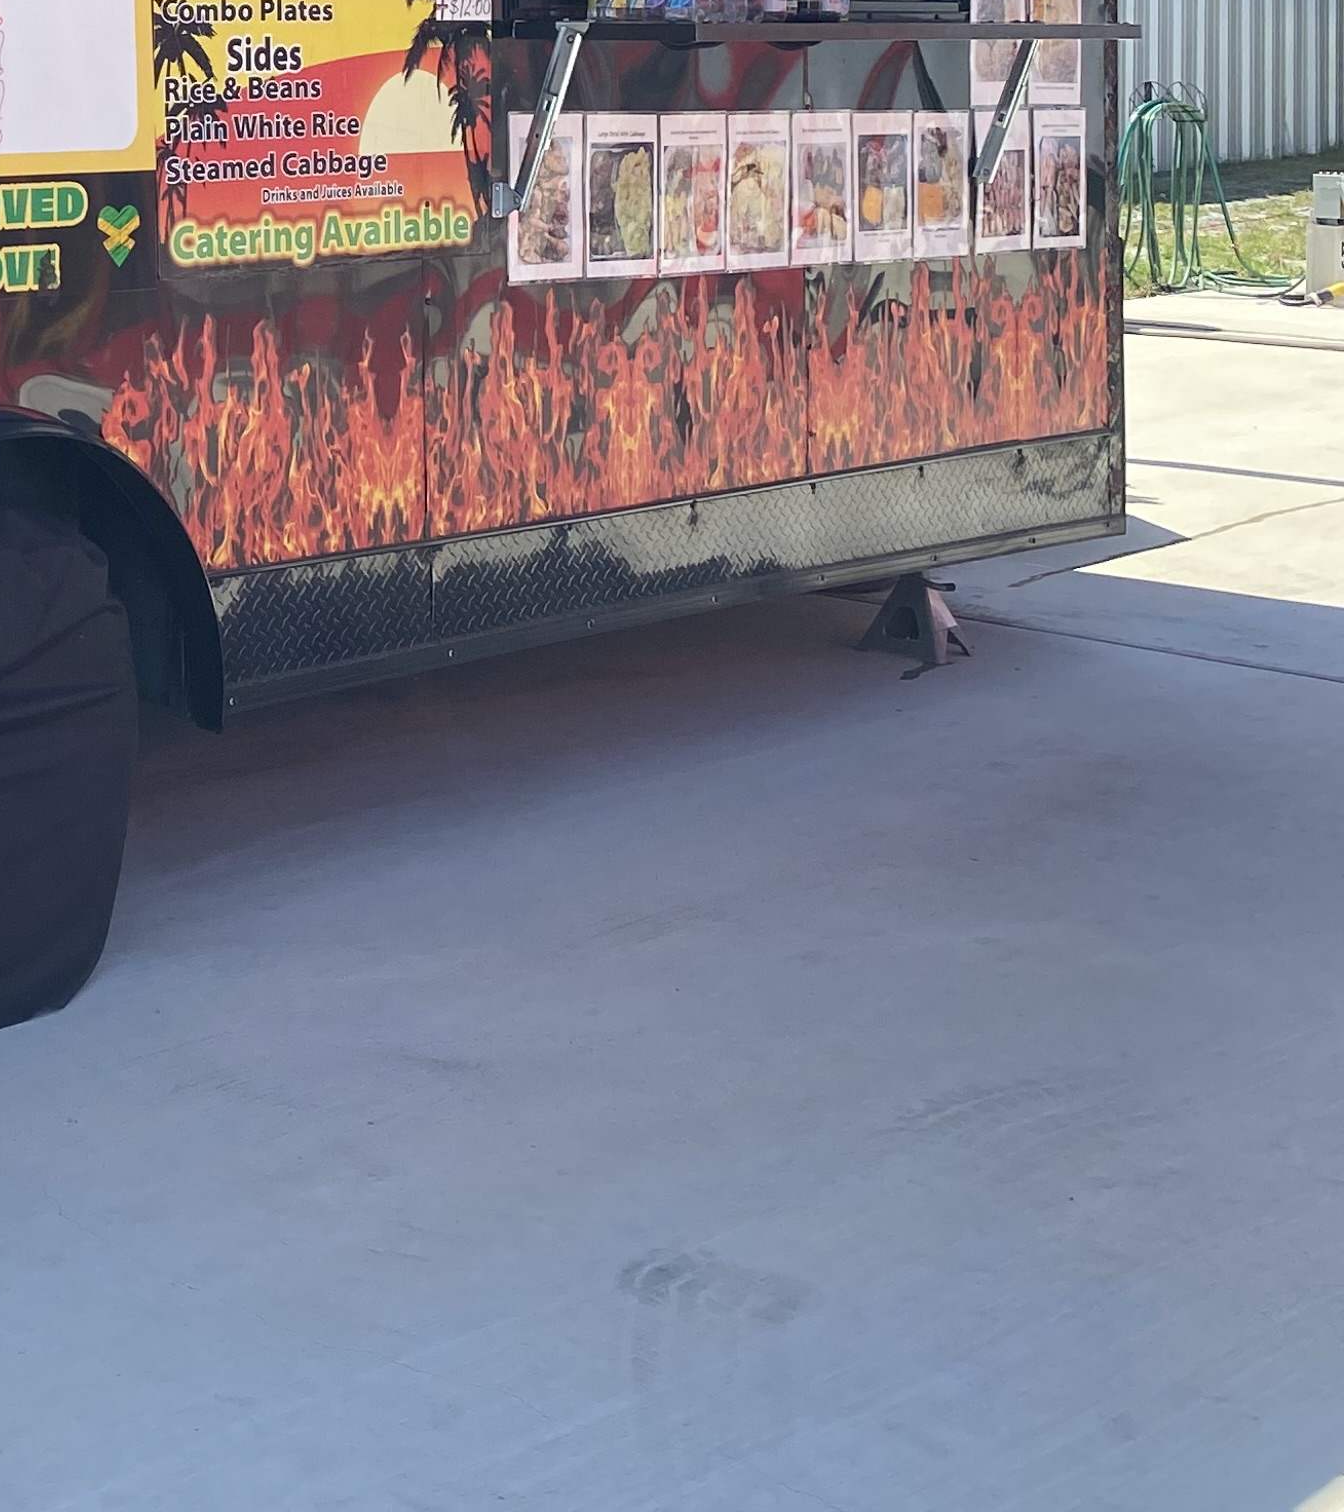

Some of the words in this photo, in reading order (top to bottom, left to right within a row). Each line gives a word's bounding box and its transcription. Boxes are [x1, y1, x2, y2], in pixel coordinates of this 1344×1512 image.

[226, 36, 303, 73] Sides
[164, 78, 217, 105] Rice
[222, 77, 241, 102] &
[247, 76, 322, 100] Beans
[165, 115, 228, 145] Plain
[233, 113, 307, 141] White
[311, 112, 360, 138] Rice
[165, 151, 276, 185] Steamed
[281, 151, 388, 181] Cabbage
[262, 188, 299, 204] Drinks
[299, 187, 320, 201] and
[320, 185, 353, 200] Juices
[354, 182, 404, 198] Available
[170, 215, 314, 263] Catering
[322, 205, 470, 251] Available
